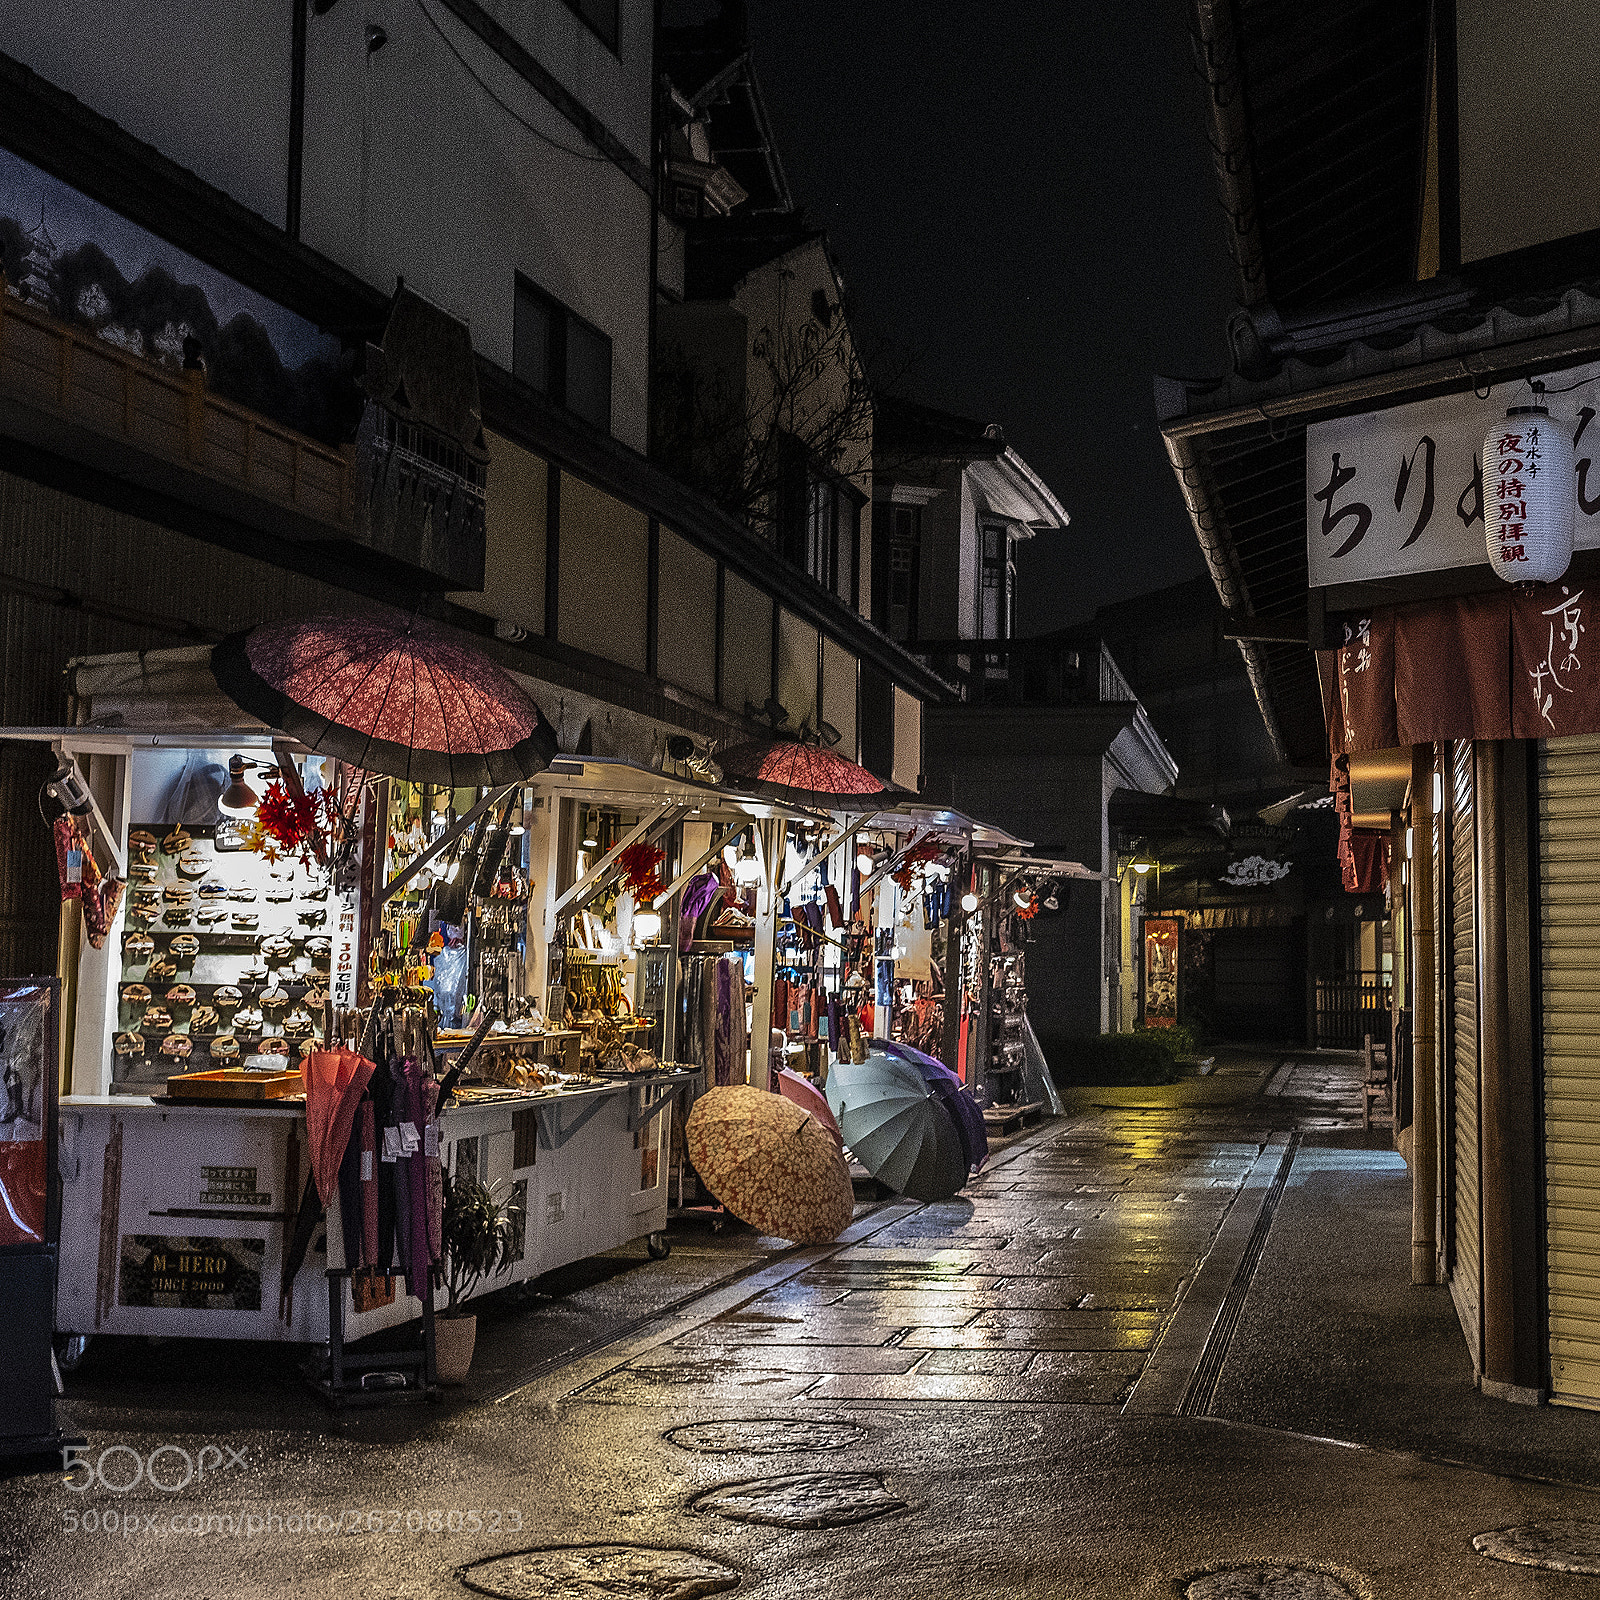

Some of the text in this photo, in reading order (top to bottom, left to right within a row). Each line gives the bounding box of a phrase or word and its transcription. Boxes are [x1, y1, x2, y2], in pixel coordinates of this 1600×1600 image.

[1525, 427, 1542, 479] 清水寺
[1497, 433, 1529, 563] 夜の特別拝観
[1235, 863, 1275, 879] Café
[153, 1254, 227, 1274] M-HERO
[151, 1277, 225, 1292] SINCE 2000
